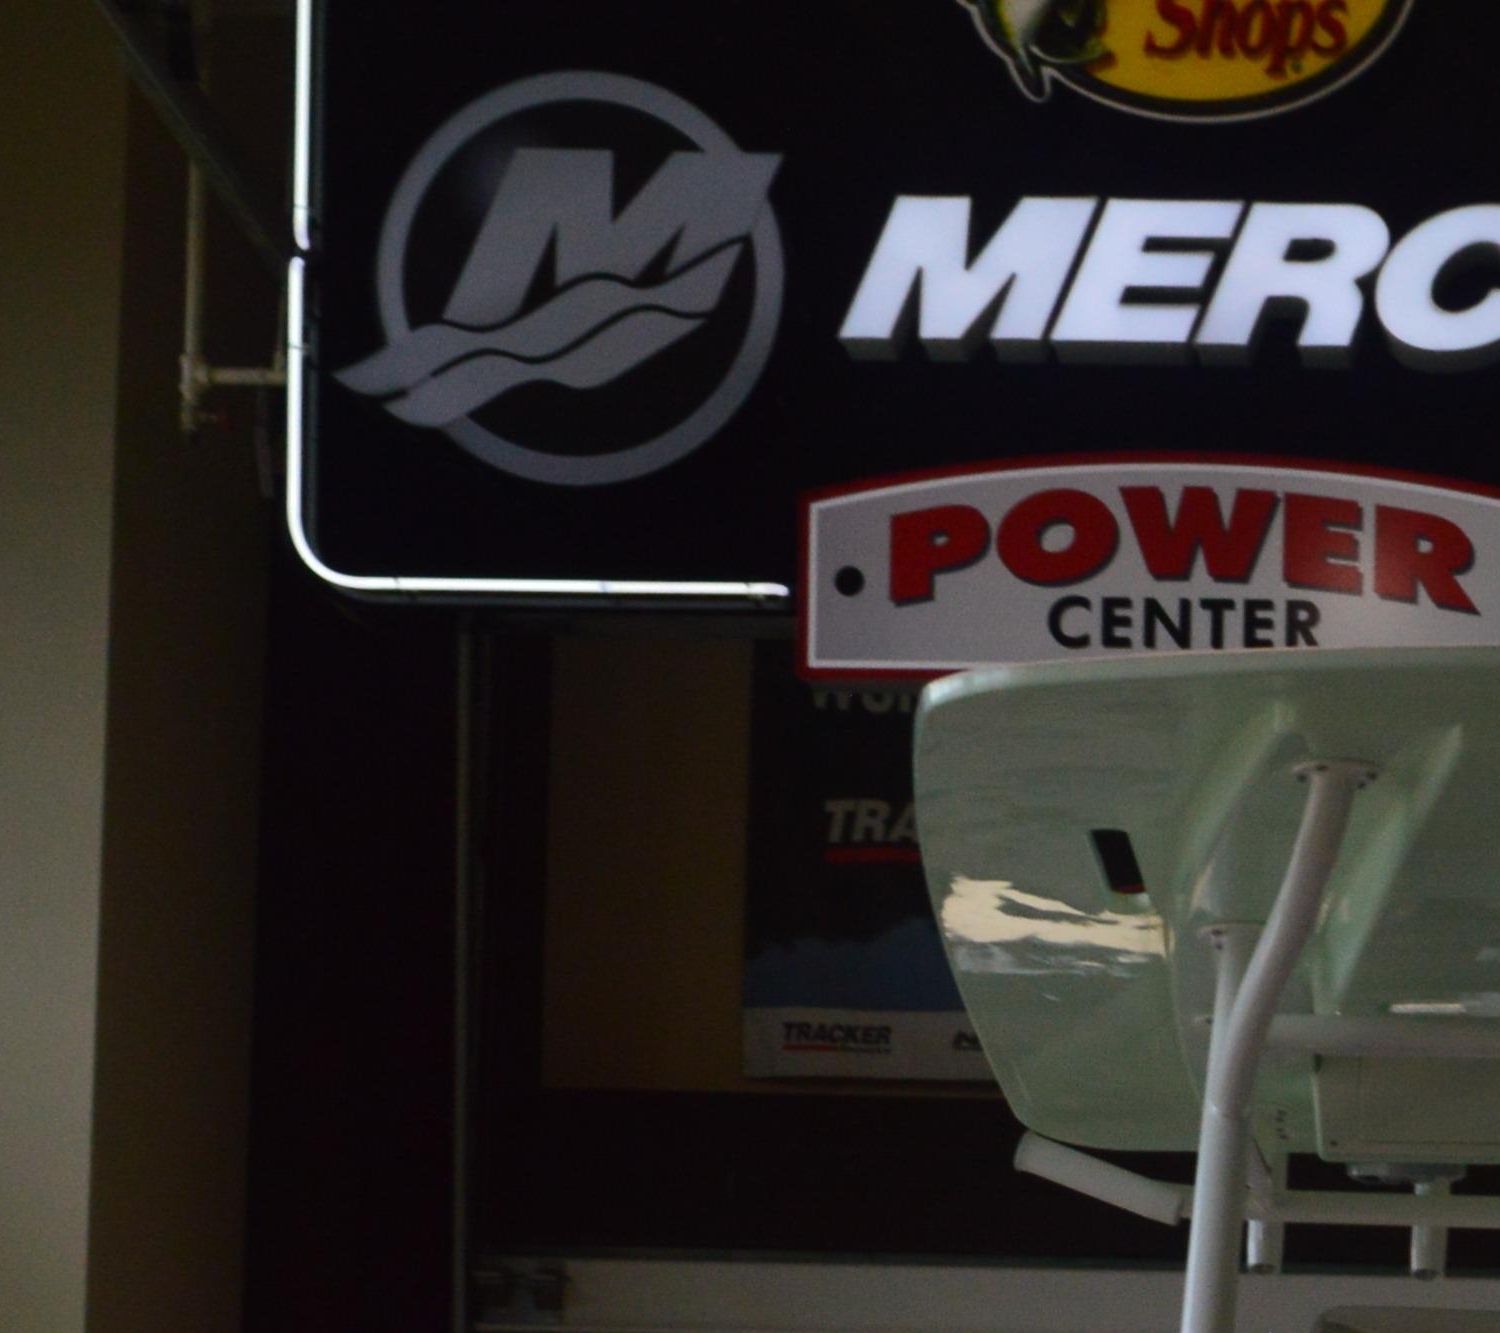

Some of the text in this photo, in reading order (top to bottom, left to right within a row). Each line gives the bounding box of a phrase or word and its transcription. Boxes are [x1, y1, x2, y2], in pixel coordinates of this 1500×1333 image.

[1145, 0, 1348, 78] Shops
[890, 486, 1481, 616] POWER
[1048, 597, 1321, 649] CENTER
[782, 1021, 892, 1046] TRACKER
